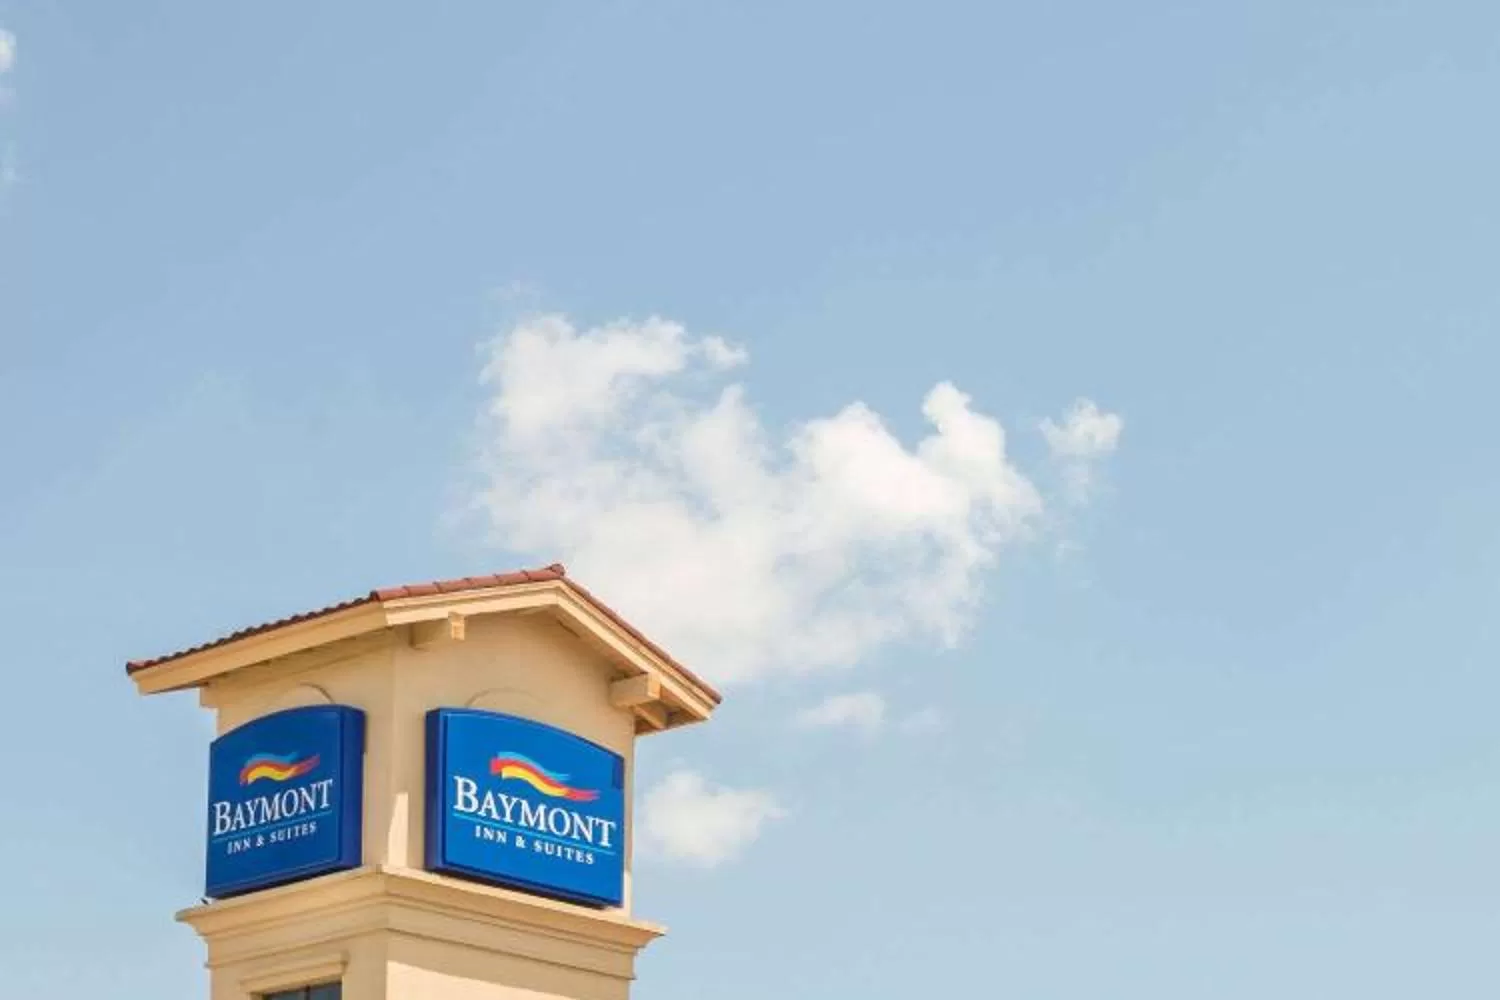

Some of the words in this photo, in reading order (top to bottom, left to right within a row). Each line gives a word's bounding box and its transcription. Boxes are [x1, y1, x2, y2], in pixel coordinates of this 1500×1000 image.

[212, 778, 333, 836] BAYMONT
[453, 775, 616, 848] BAYMONT
[227, 837, 251, 855] INN
[255, 835, 265, 847] &
[269, 821, 317, 843] SUITES
[474, 825, 507, 844] INN
[515, 835, 526, 849] &
[533, 839, 594, 865] SUITES
